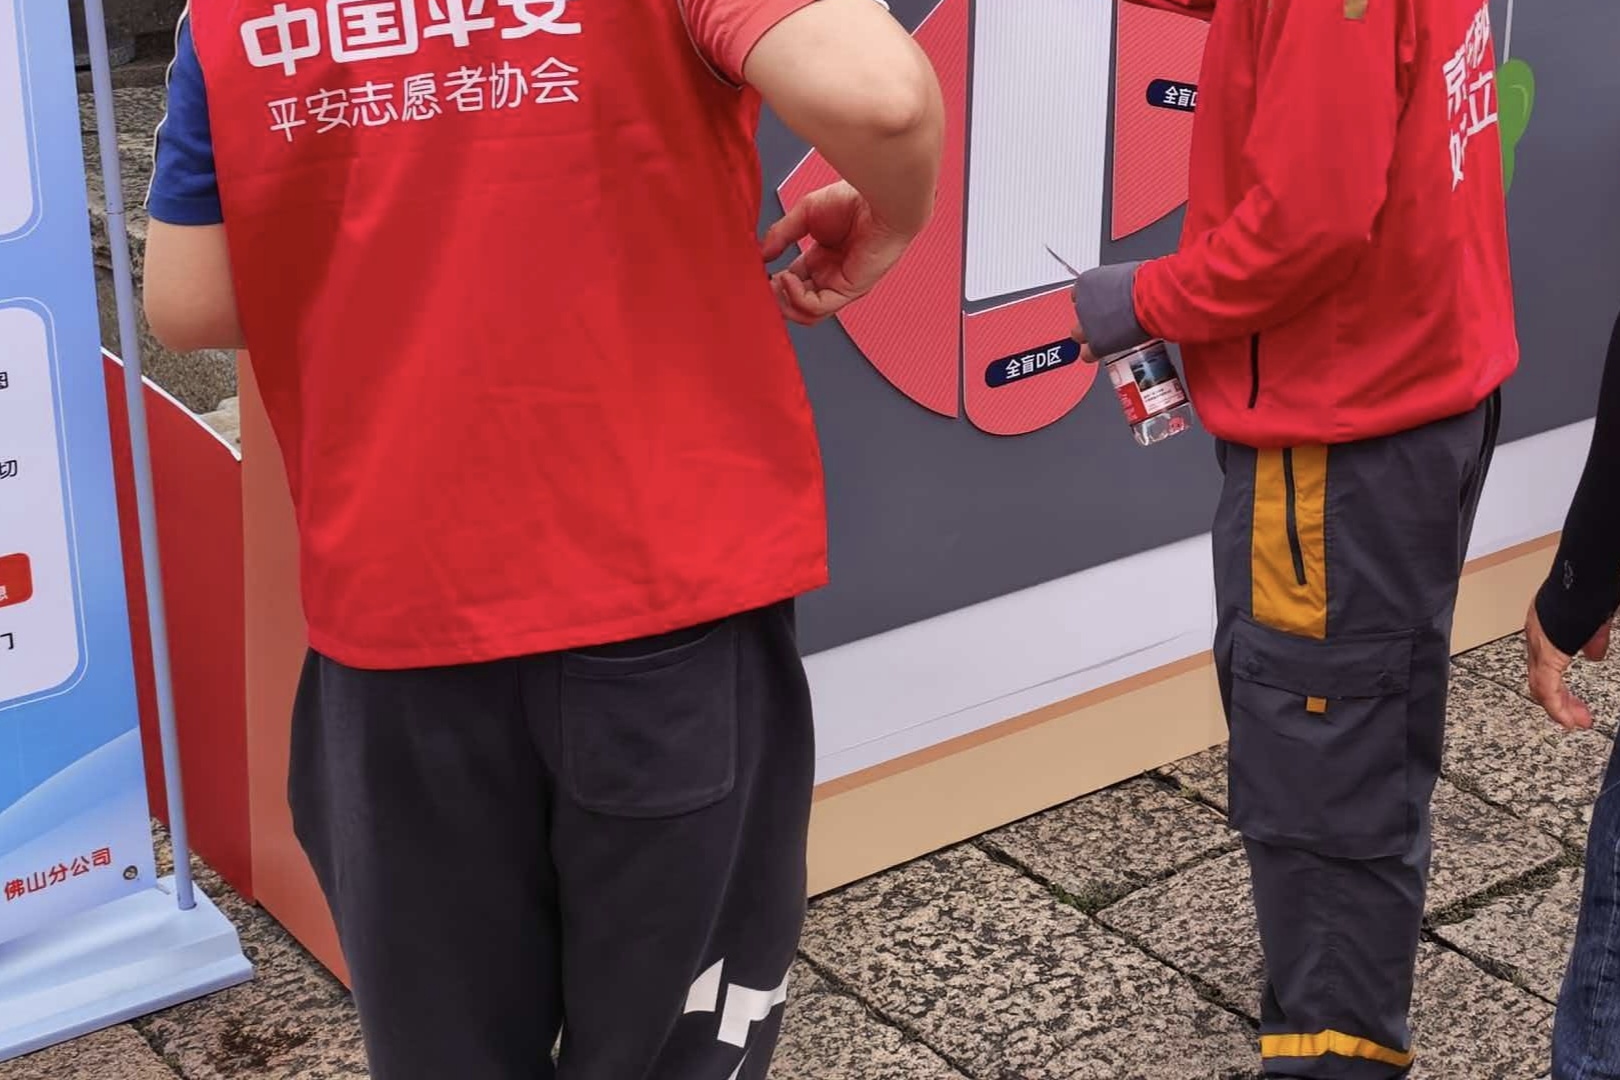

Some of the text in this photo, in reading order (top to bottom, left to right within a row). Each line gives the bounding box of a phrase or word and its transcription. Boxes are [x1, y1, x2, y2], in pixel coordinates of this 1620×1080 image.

[267, 56, 580, 142] 平安志愿者协会
[1005, 345, 1062, 380] 全盲D区
[4, 847, 111, 901] 佛山分公司
